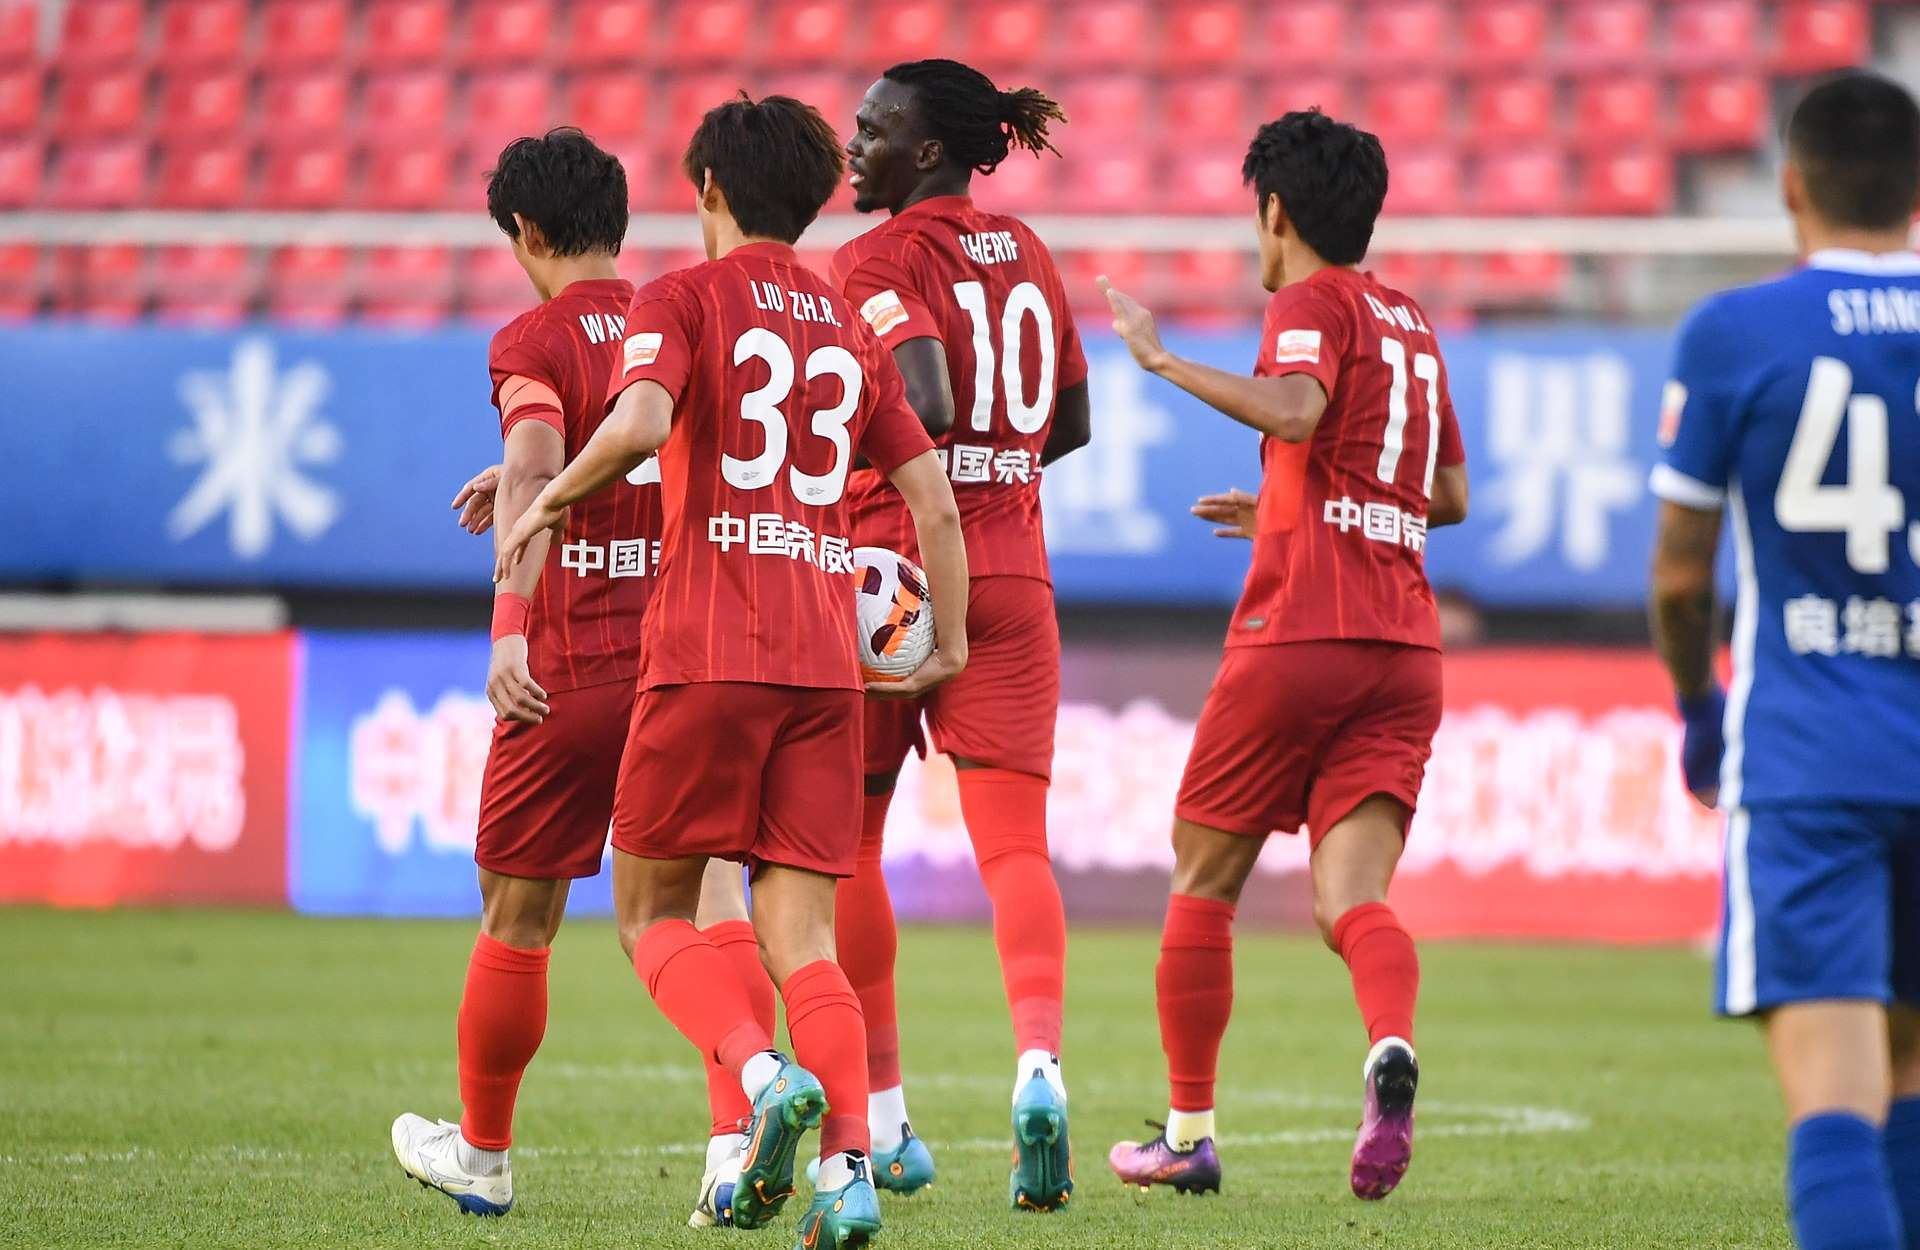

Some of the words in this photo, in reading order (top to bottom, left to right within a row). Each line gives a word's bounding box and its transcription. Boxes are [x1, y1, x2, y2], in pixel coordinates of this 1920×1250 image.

[958, 231, 1018, 265] CHERIF
[750, 279, 784, 313] LIU
[787, 290, 843, 328] ZH.R.
[953, 280, 1055, 434] 10
[721, 326, 863, 507] 33
[1376, 336, 1439, 501] 11
[1773, 355, 1920, 575] 4
[561, 538, 663, 579] 中国
[708, 511, 855, 575] 中国荣威
